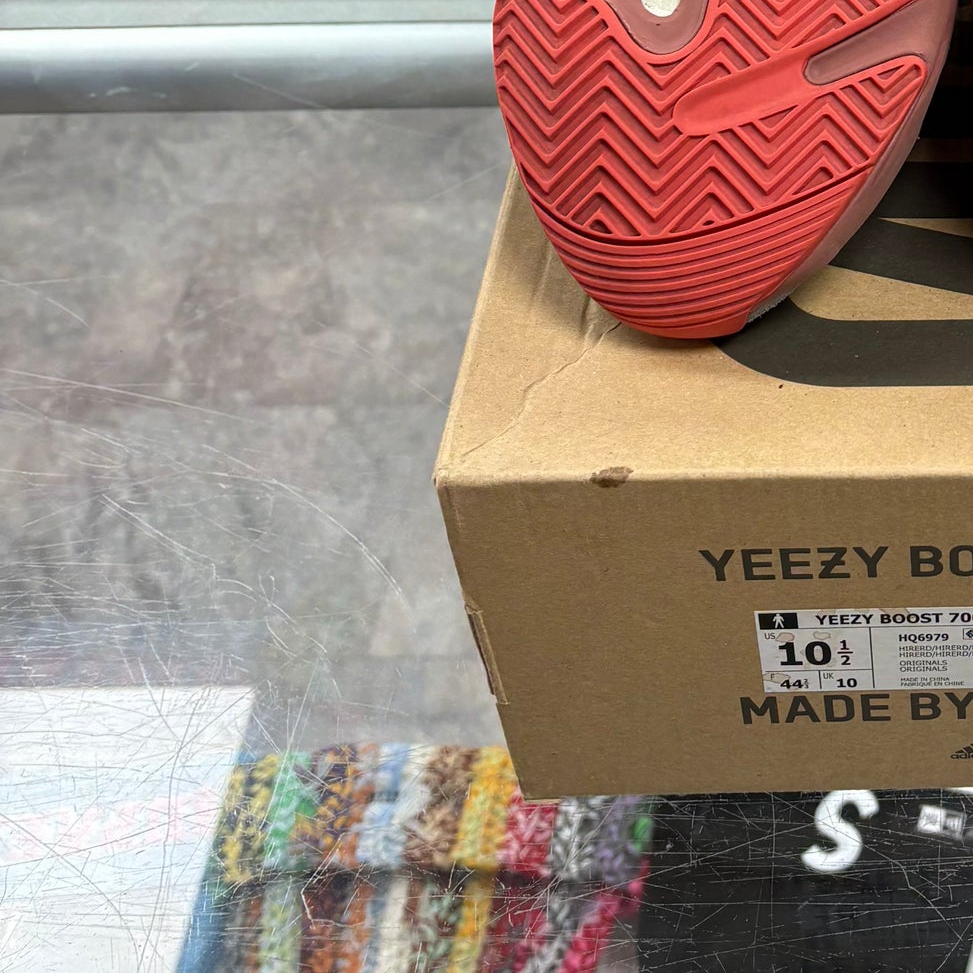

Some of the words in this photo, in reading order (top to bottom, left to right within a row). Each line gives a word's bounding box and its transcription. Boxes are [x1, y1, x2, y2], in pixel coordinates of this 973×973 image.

[699, 546, 889, 582] YEEZY
[815, 614, 874, 625] YEEZY
[880, 613, 943, 624] BOOST
[898, 633, 949, 643] HQ6979
[778, 641, 832, 666] 10
[837, 678, 858, 688] 10
[739, 693, 892, 725] MADE
